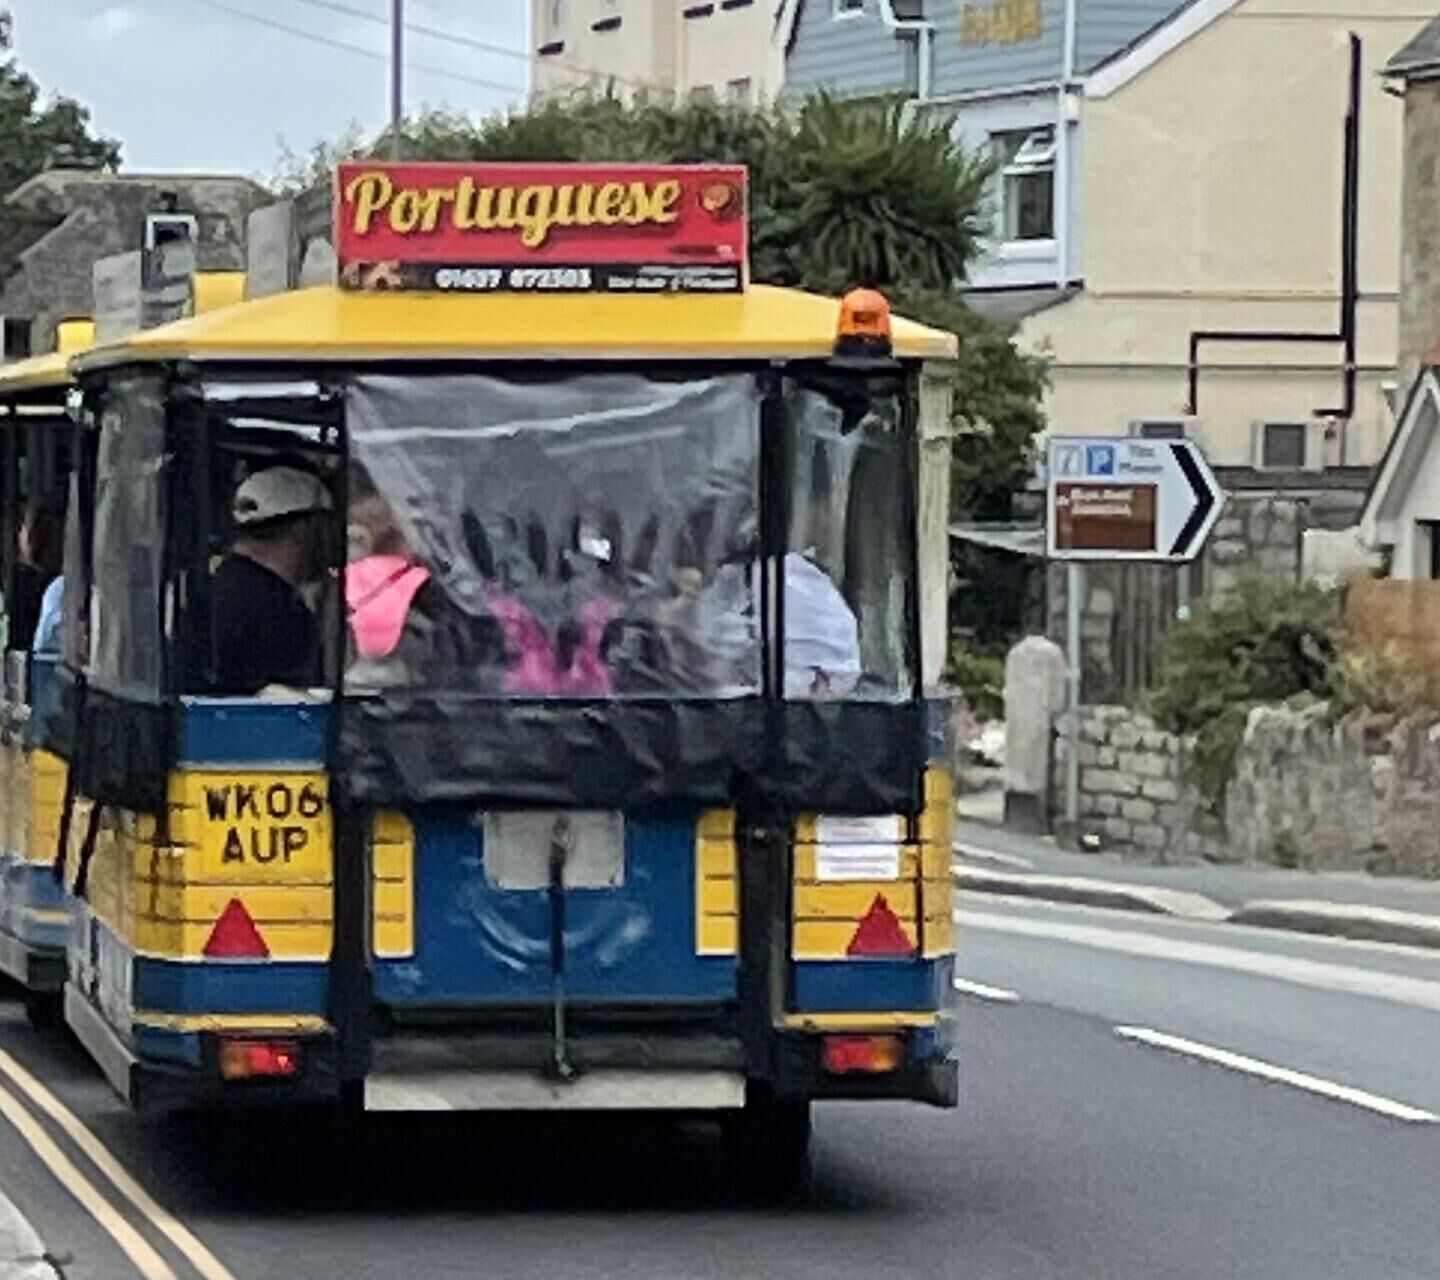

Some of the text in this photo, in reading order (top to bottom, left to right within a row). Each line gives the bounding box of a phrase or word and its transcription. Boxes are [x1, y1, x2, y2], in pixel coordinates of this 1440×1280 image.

[345, 172, 681, 247] Portuguese
[203, 783, 324, 821] WK06
[222, 826, 308, 863] AUP
